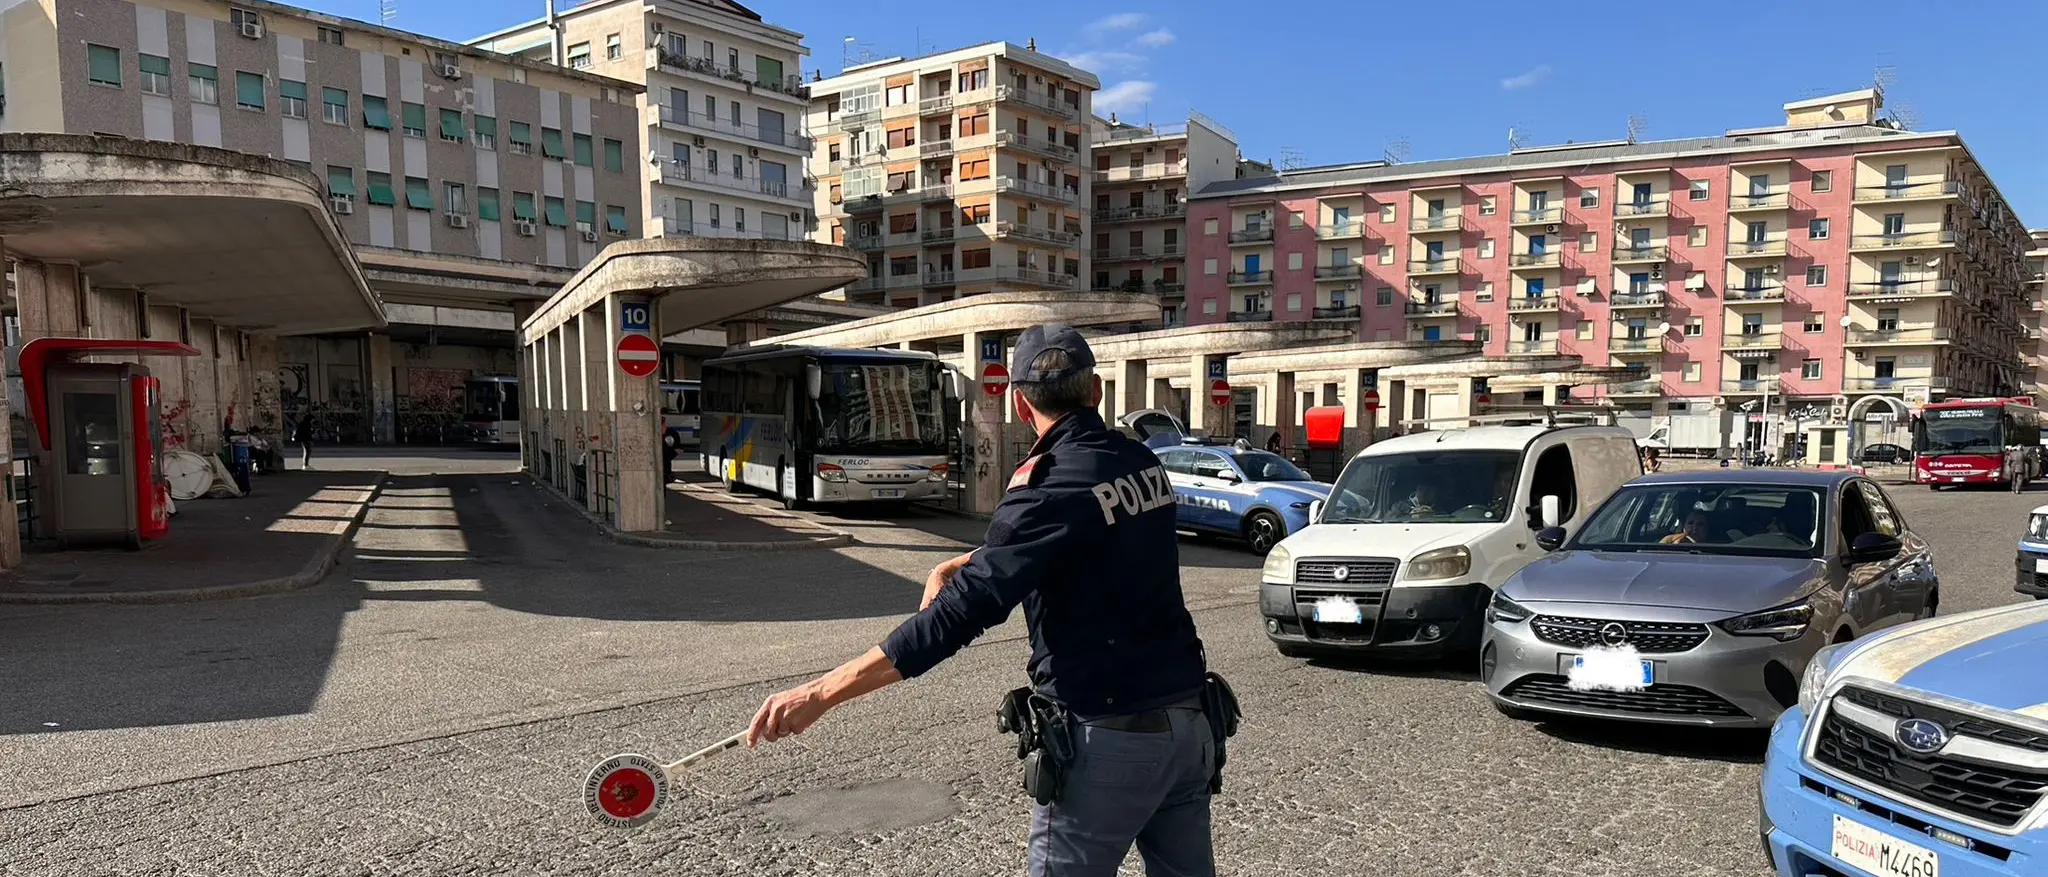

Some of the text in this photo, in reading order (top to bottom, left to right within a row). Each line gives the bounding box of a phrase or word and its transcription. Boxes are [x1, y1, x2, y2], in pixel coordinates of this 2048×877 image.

[624, 308, 647, 325] 10
[984, 343, 998, 356] 11
[1211, 363, 1223, 374] 12
[1091, 465, 1176, 526] POLIZI
[1175, 493, 1231, 512] OLIZIA
[631, 758, 667, 809] POLIZIA DI STATO
[1836, 831, 1933, 877] POLIZIA M4469
